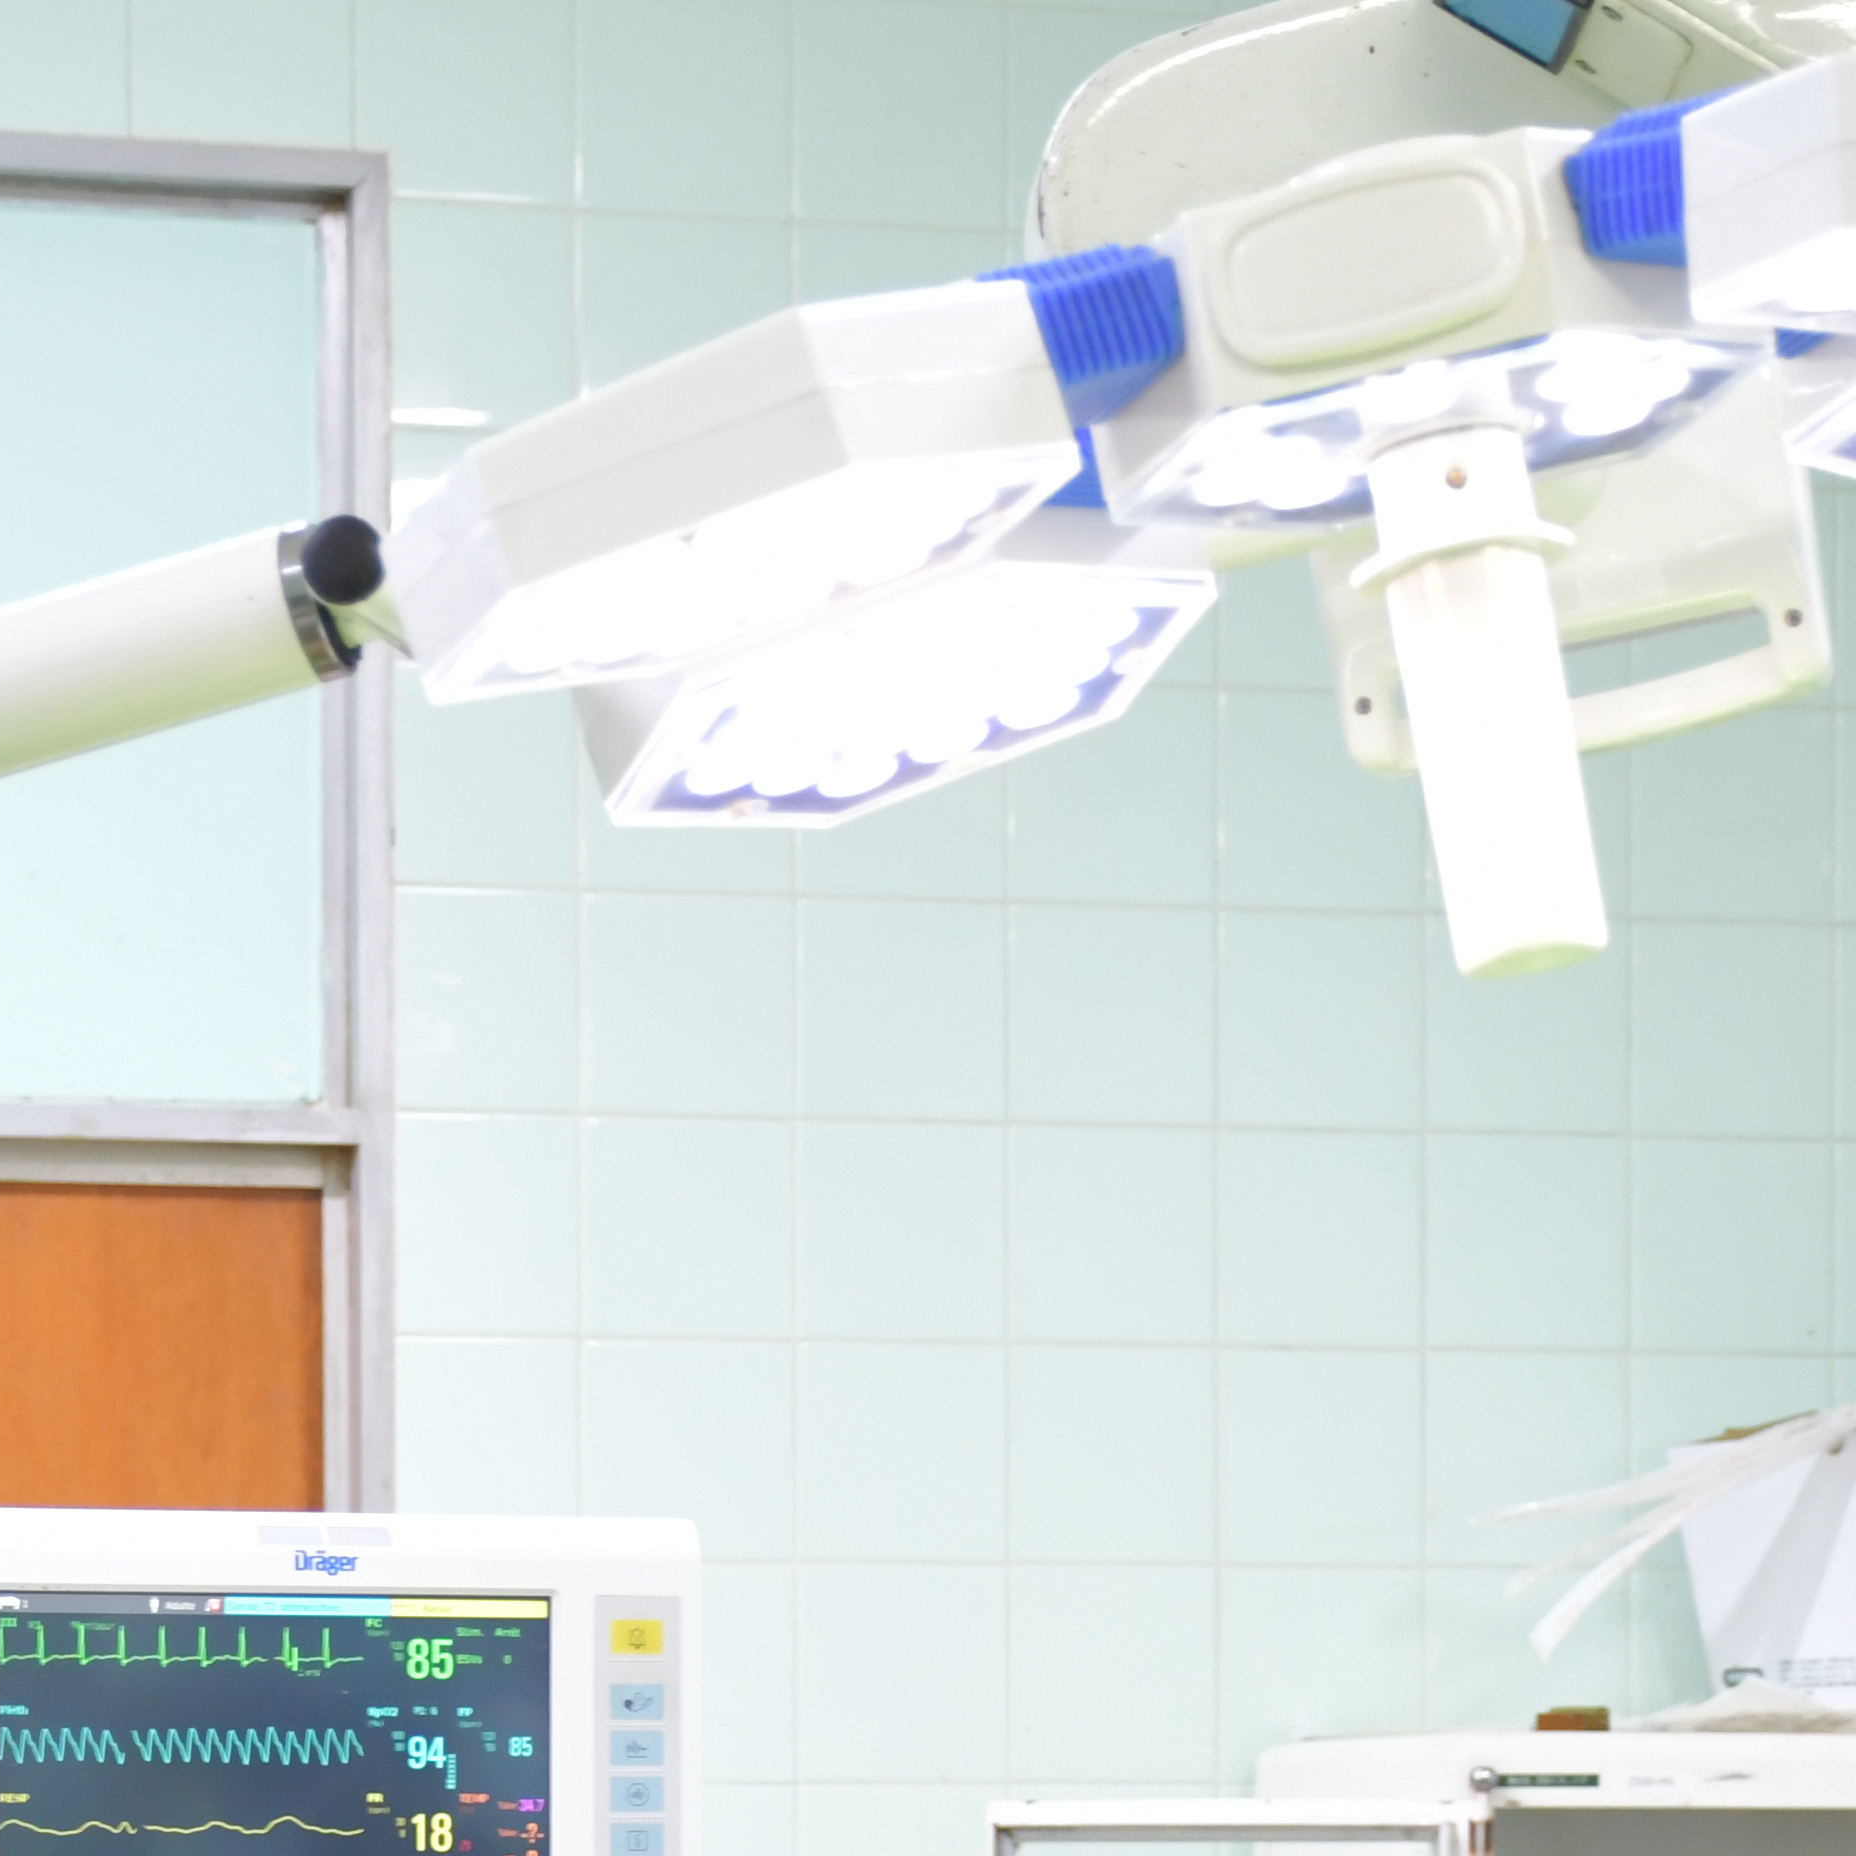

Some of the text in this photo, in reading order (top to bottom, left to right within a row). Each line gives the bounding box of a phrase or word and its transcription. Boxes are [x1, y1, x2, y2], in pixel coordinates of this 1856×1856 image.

[294, 1550, 359, 1575] Dräger
[365, 1618, 383, 1628] FC
[406, 1636, 455, 1680] 85
[406, 1735, 448, 1769] 94
[507, 1736, 534, 1758] 85
[410, 1812, 454, 1853] 18
